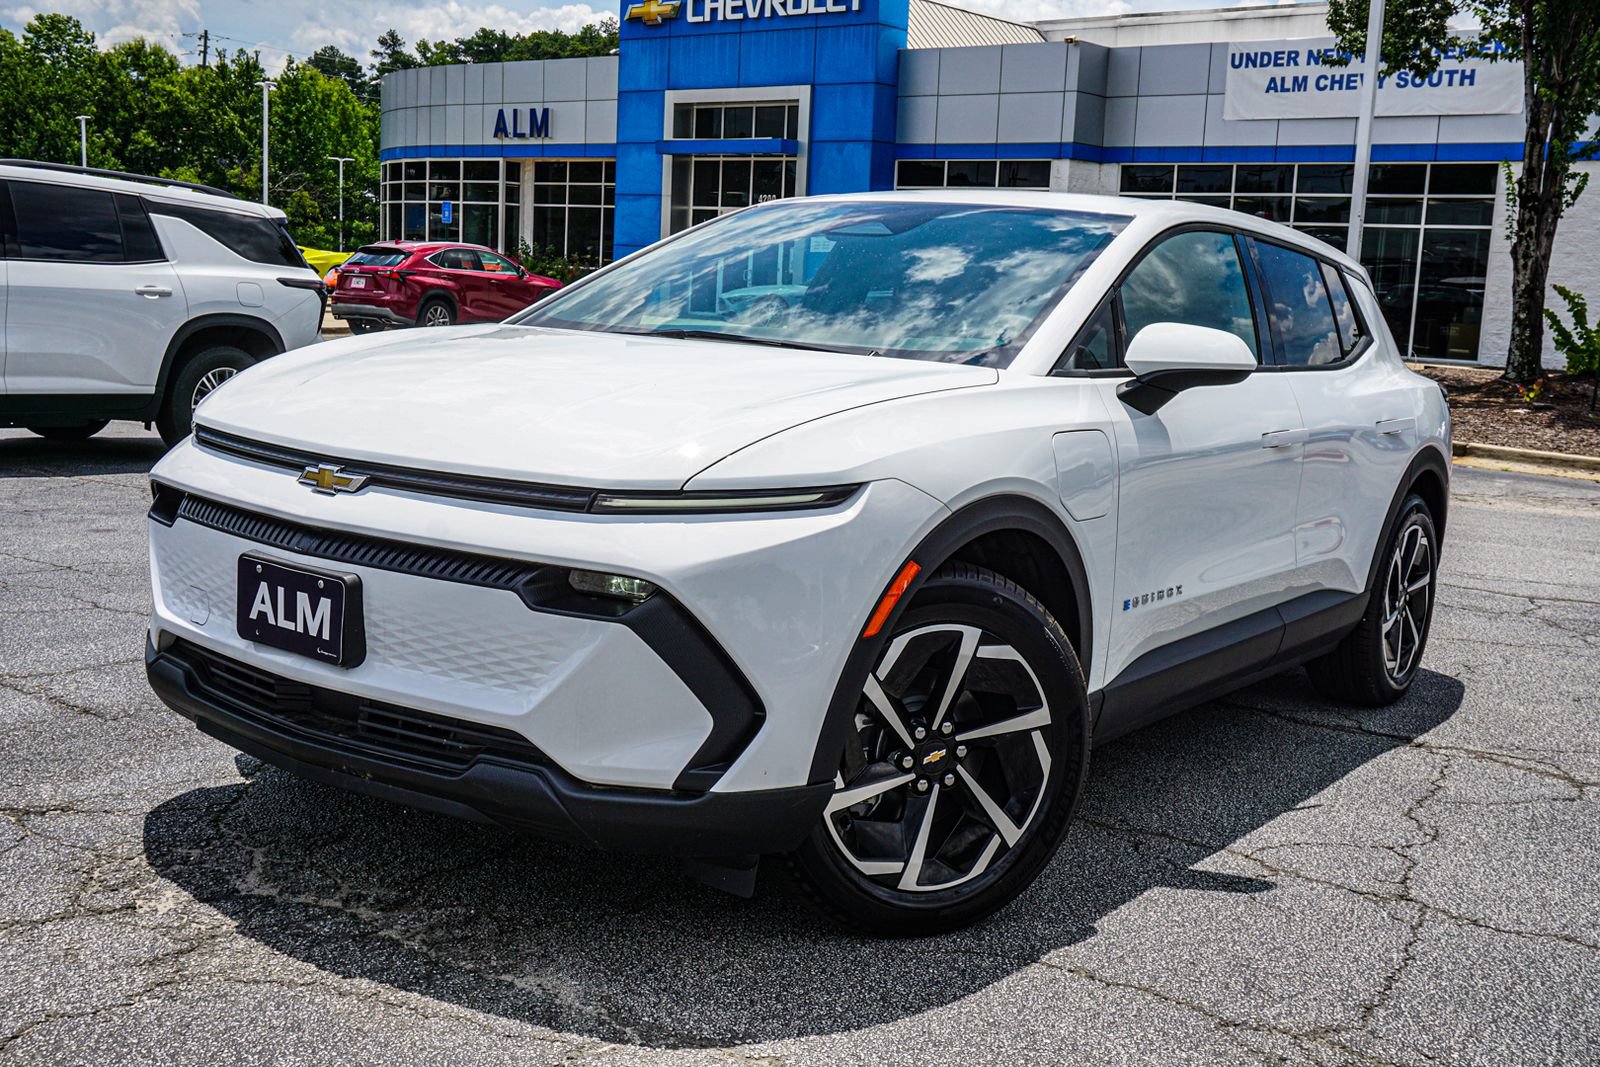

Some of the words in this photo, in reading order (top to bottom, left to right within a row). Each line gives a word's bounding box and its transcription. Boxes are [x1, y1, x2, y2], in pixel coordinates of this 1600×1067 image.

[1231, 50, 1299, 69] UNDER
[1265, 75, 1308, 93] ALM
[1395, 69, 1476, 89] SOUTH
[493, 108, 549, 138] ALM
[249, 581, 332, 640] ALM
[1122, 585, 1183, 611] EQUINOX
